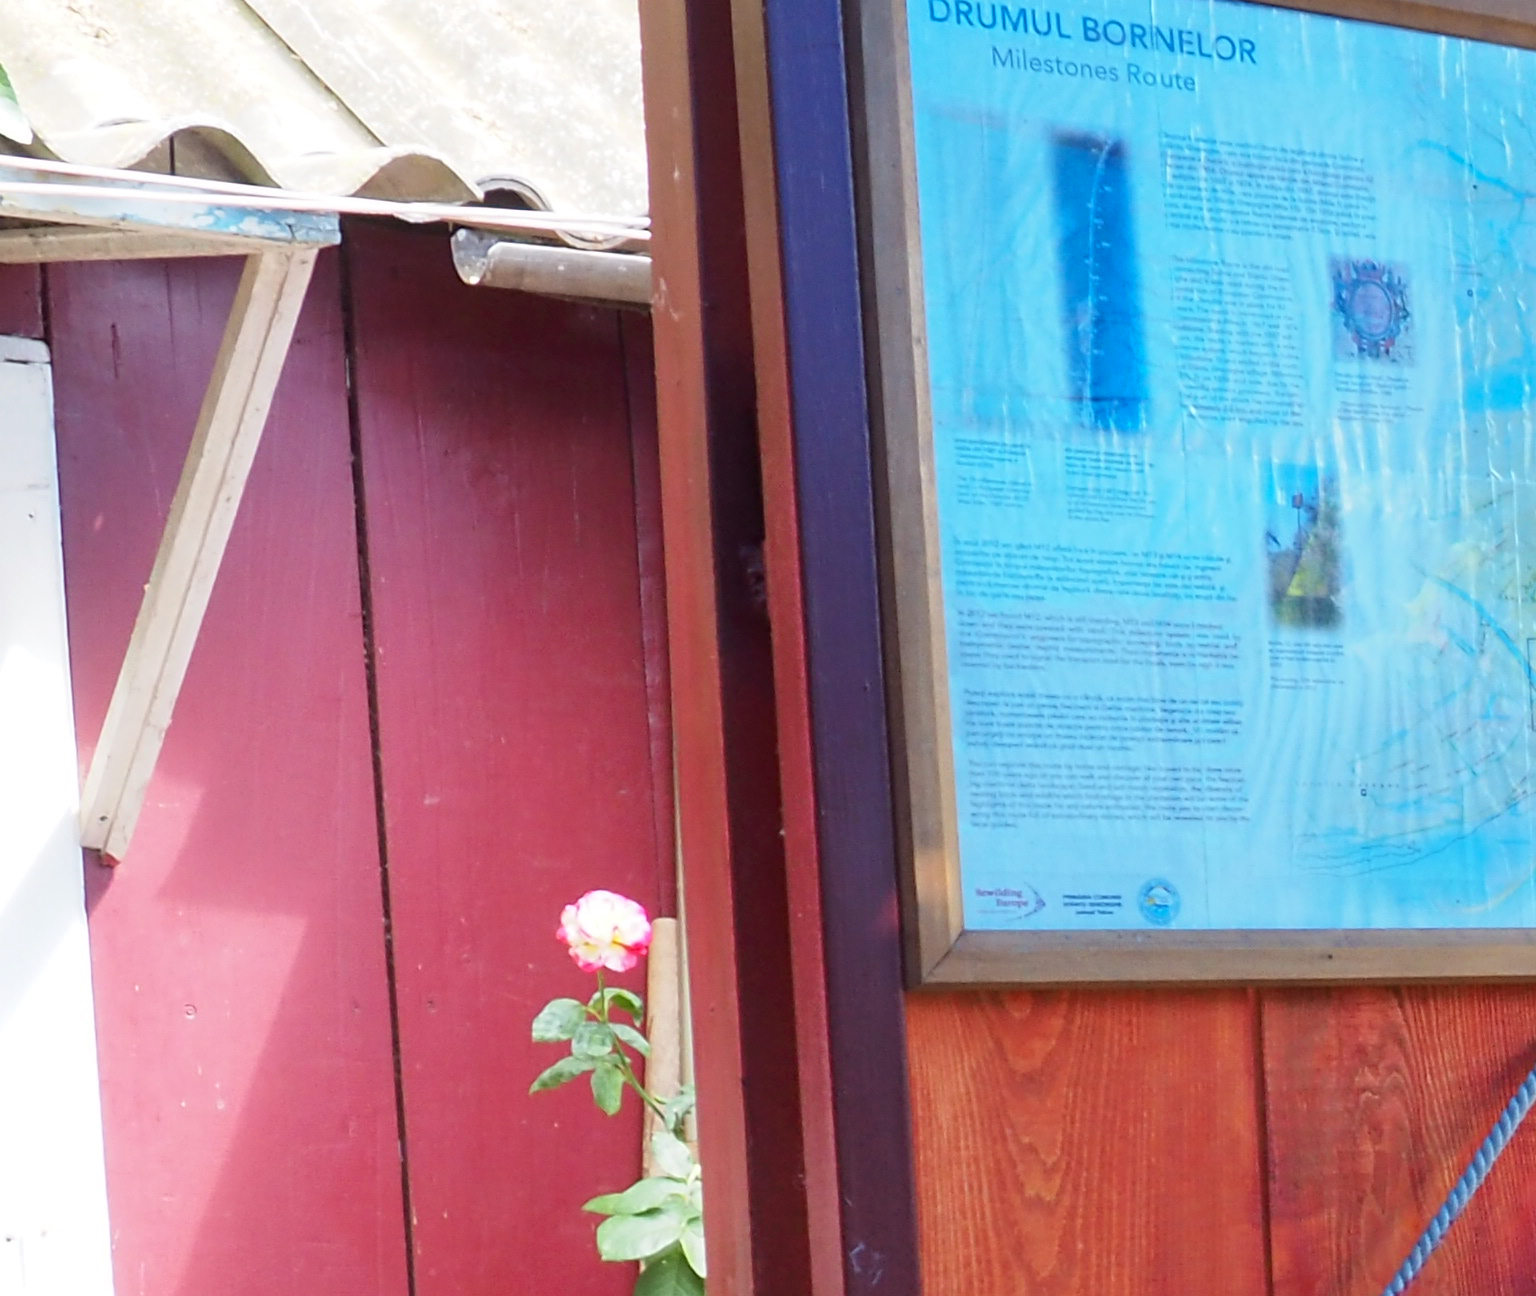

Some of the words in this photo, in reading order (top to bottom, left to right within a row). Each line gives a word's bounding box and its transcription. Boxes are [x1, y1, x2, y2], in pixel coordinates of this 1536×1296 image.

[929, 0, 1072, 39] DRUMUL
[1082, 16, 1257, 64] BORNELOR
[991, 46, 1119, 83] Milestones
[1126, 63, 1196, 92] Route
